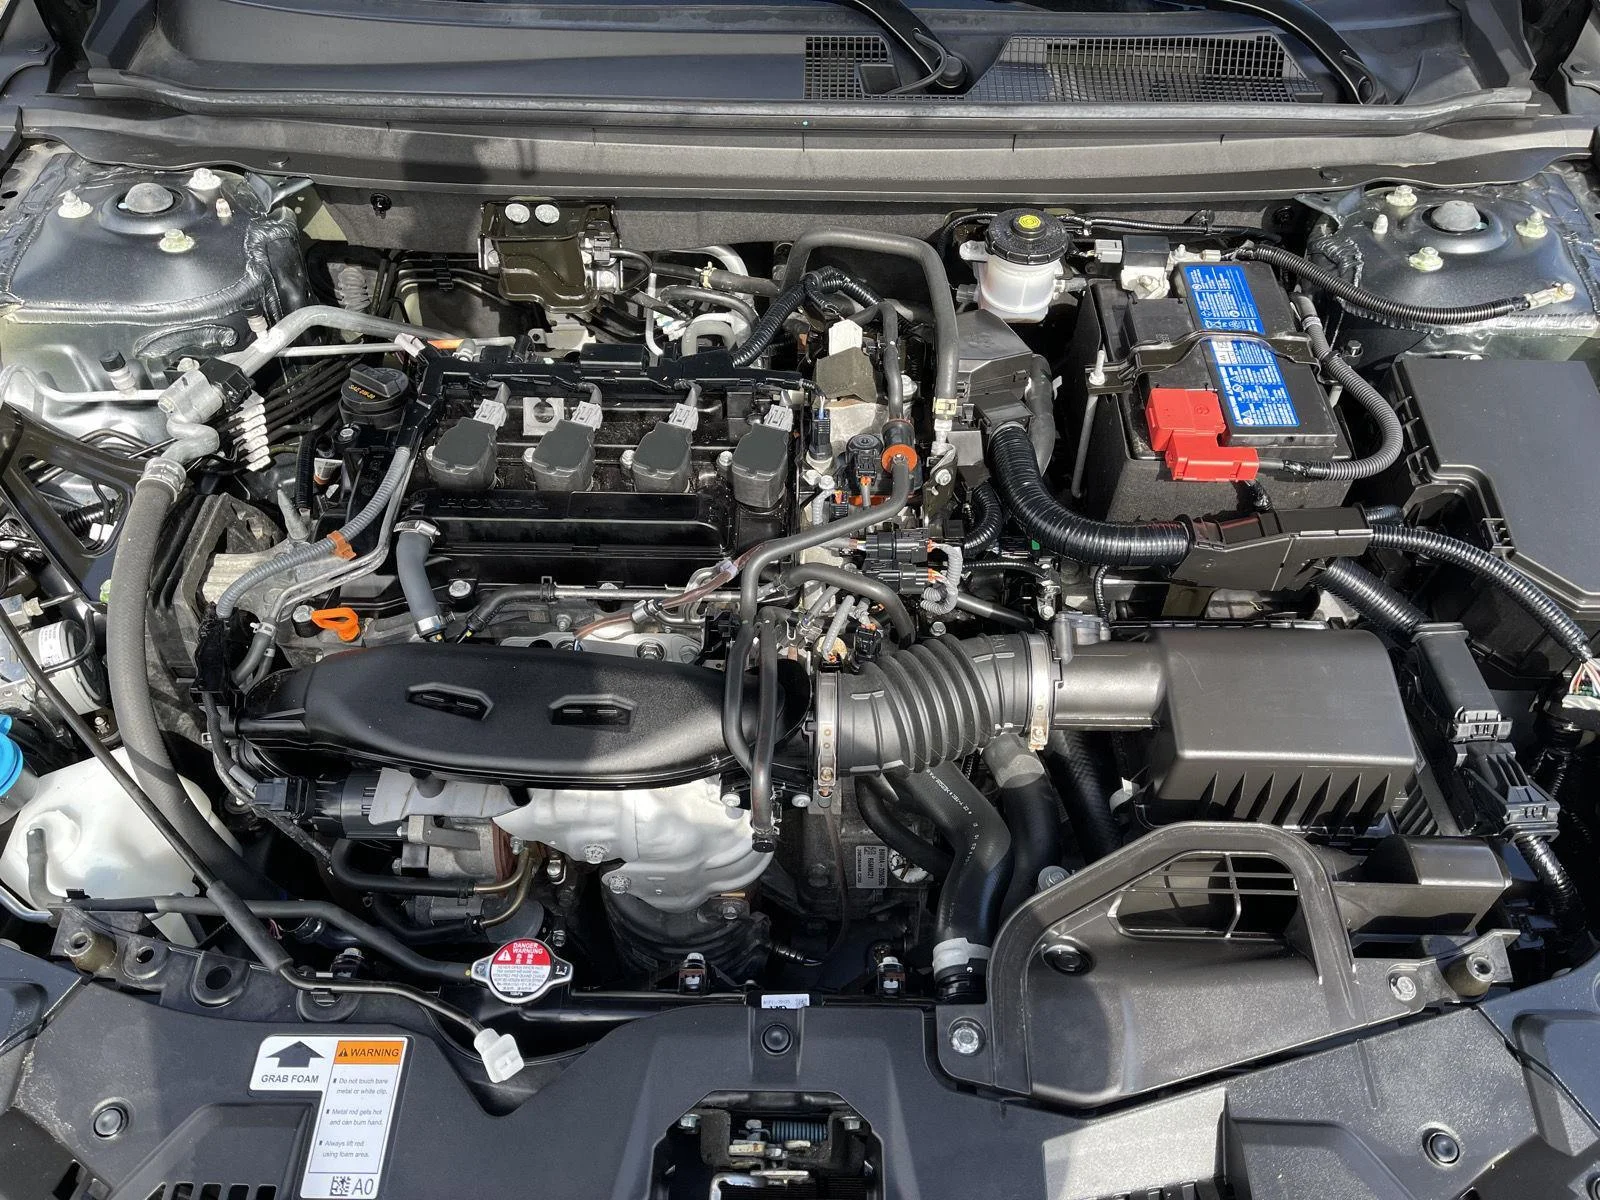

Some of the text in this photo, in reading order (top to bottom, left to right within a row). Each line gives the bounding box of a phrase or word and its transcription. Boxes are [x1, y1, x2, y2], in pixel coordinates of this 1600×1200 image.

[350, 1048, 399, 1057] WARNING
[261, 1074, 319, 1083] GRAB FOAM
[325, 1140, 346, 1148] Always
[322, 1151, 338, 1159] using
[351, 1178, 374, 1195] A0
